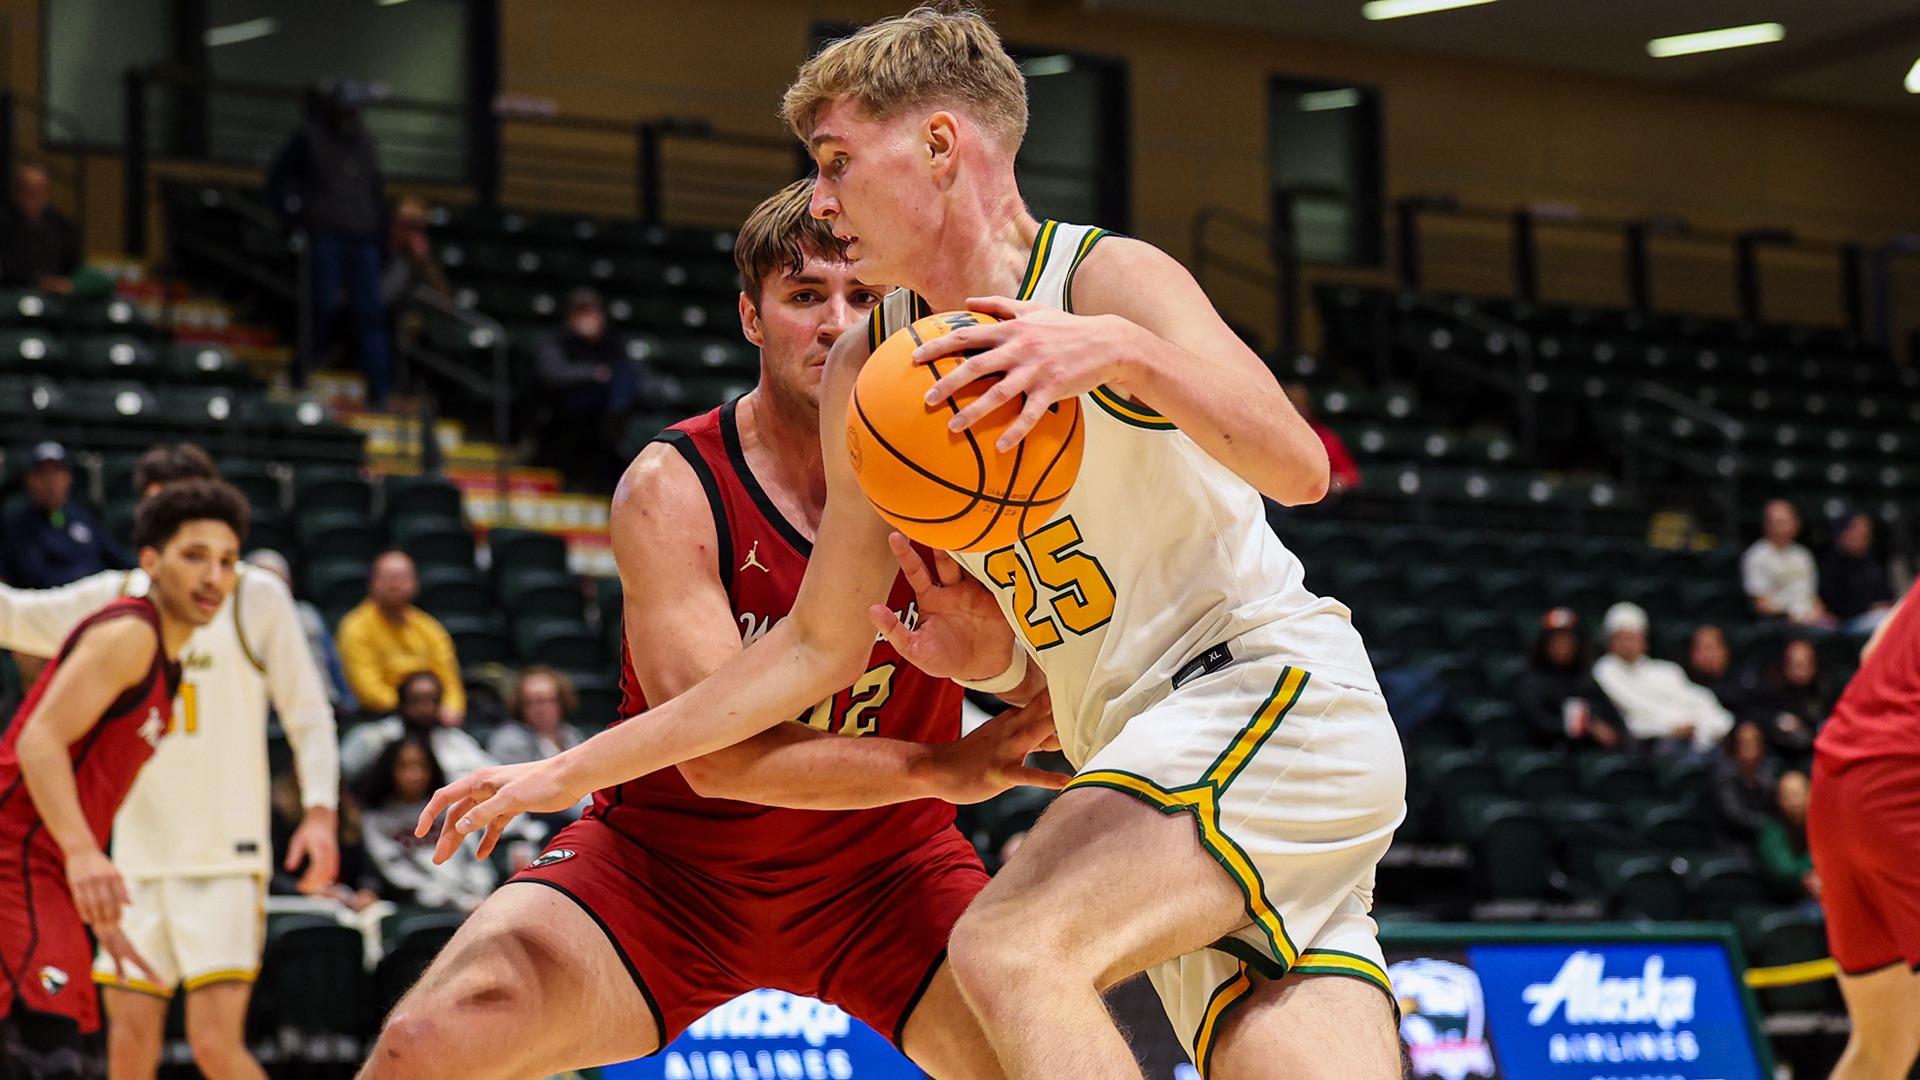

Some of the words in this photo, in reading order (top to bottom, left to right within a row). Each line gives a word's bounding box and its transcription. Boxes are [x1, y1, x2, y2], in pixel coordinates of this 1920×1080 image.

[984, 514, 1117, 651] 25
[1208, 650, 1222, 662] XL
[1522, 950, 1698, 1030] Alaska
[684, 987, 850, 1046] aska
[664, 1048, 853, 1080] AIRLINES
[1548, 1031, 1700, 1064] AIRLINES
